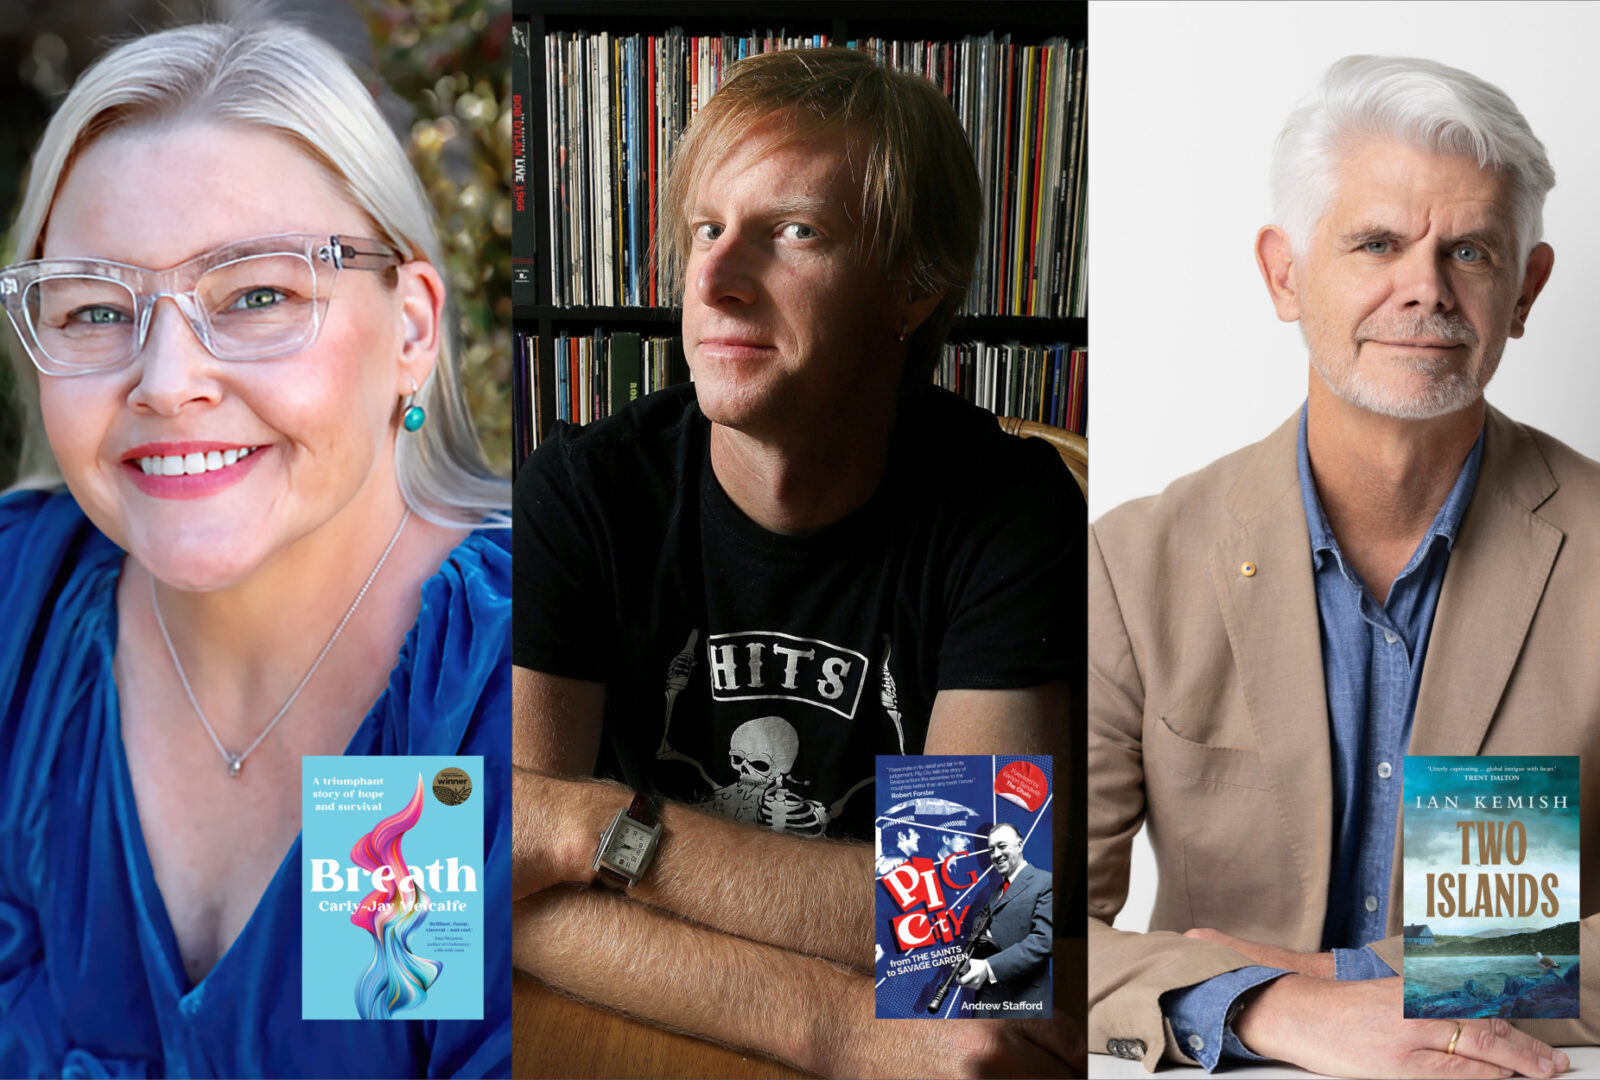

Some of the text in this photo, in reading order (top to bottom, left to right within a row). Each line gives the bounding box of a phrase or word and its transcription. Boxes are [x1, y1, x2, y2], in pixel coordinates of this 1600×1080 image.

[512, 94, 526, 212] BOB DYLAN LIVE 1966
[710, 642, 852, 700] HITS
